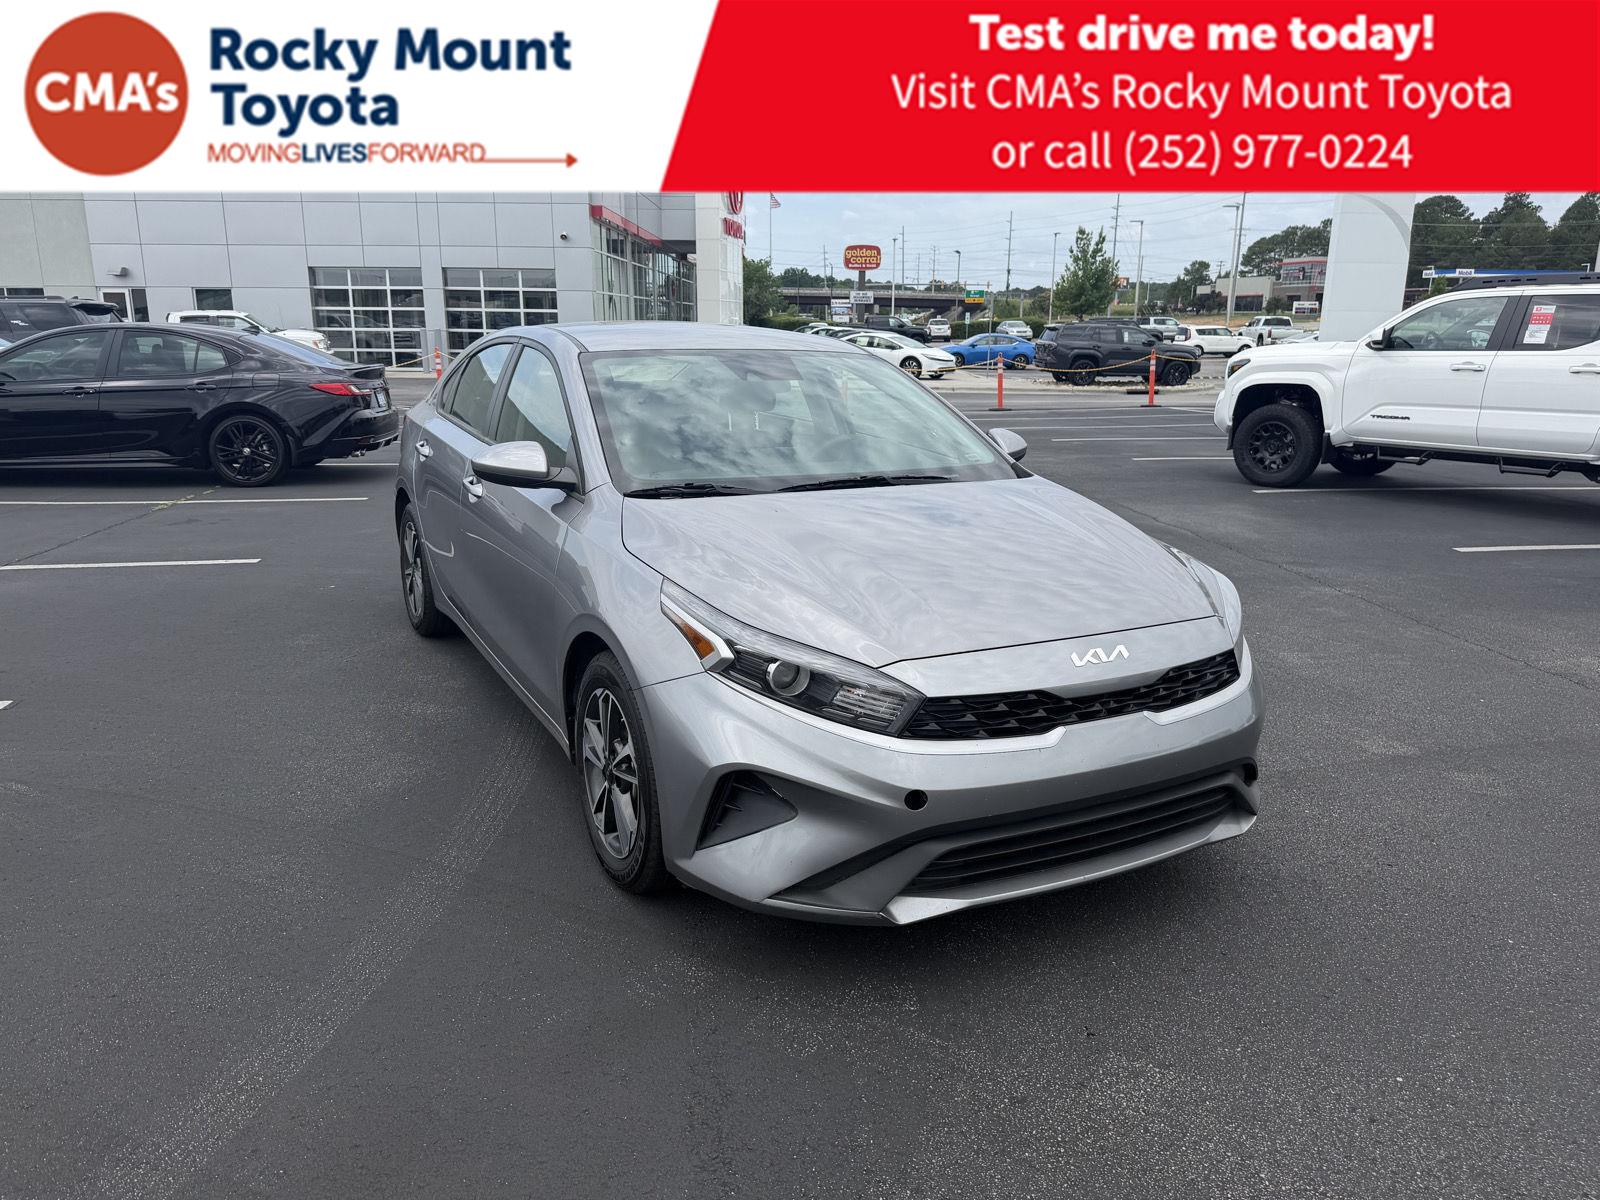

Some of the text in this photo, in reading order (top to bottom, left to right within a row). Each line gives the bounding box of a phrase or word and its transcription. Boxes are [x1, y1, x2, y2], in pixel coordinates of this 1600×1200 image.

[845, 248, 877, 258] golden
[850, 255, 880, 264] corral
[1070, 644, 1130, 667] KIA
